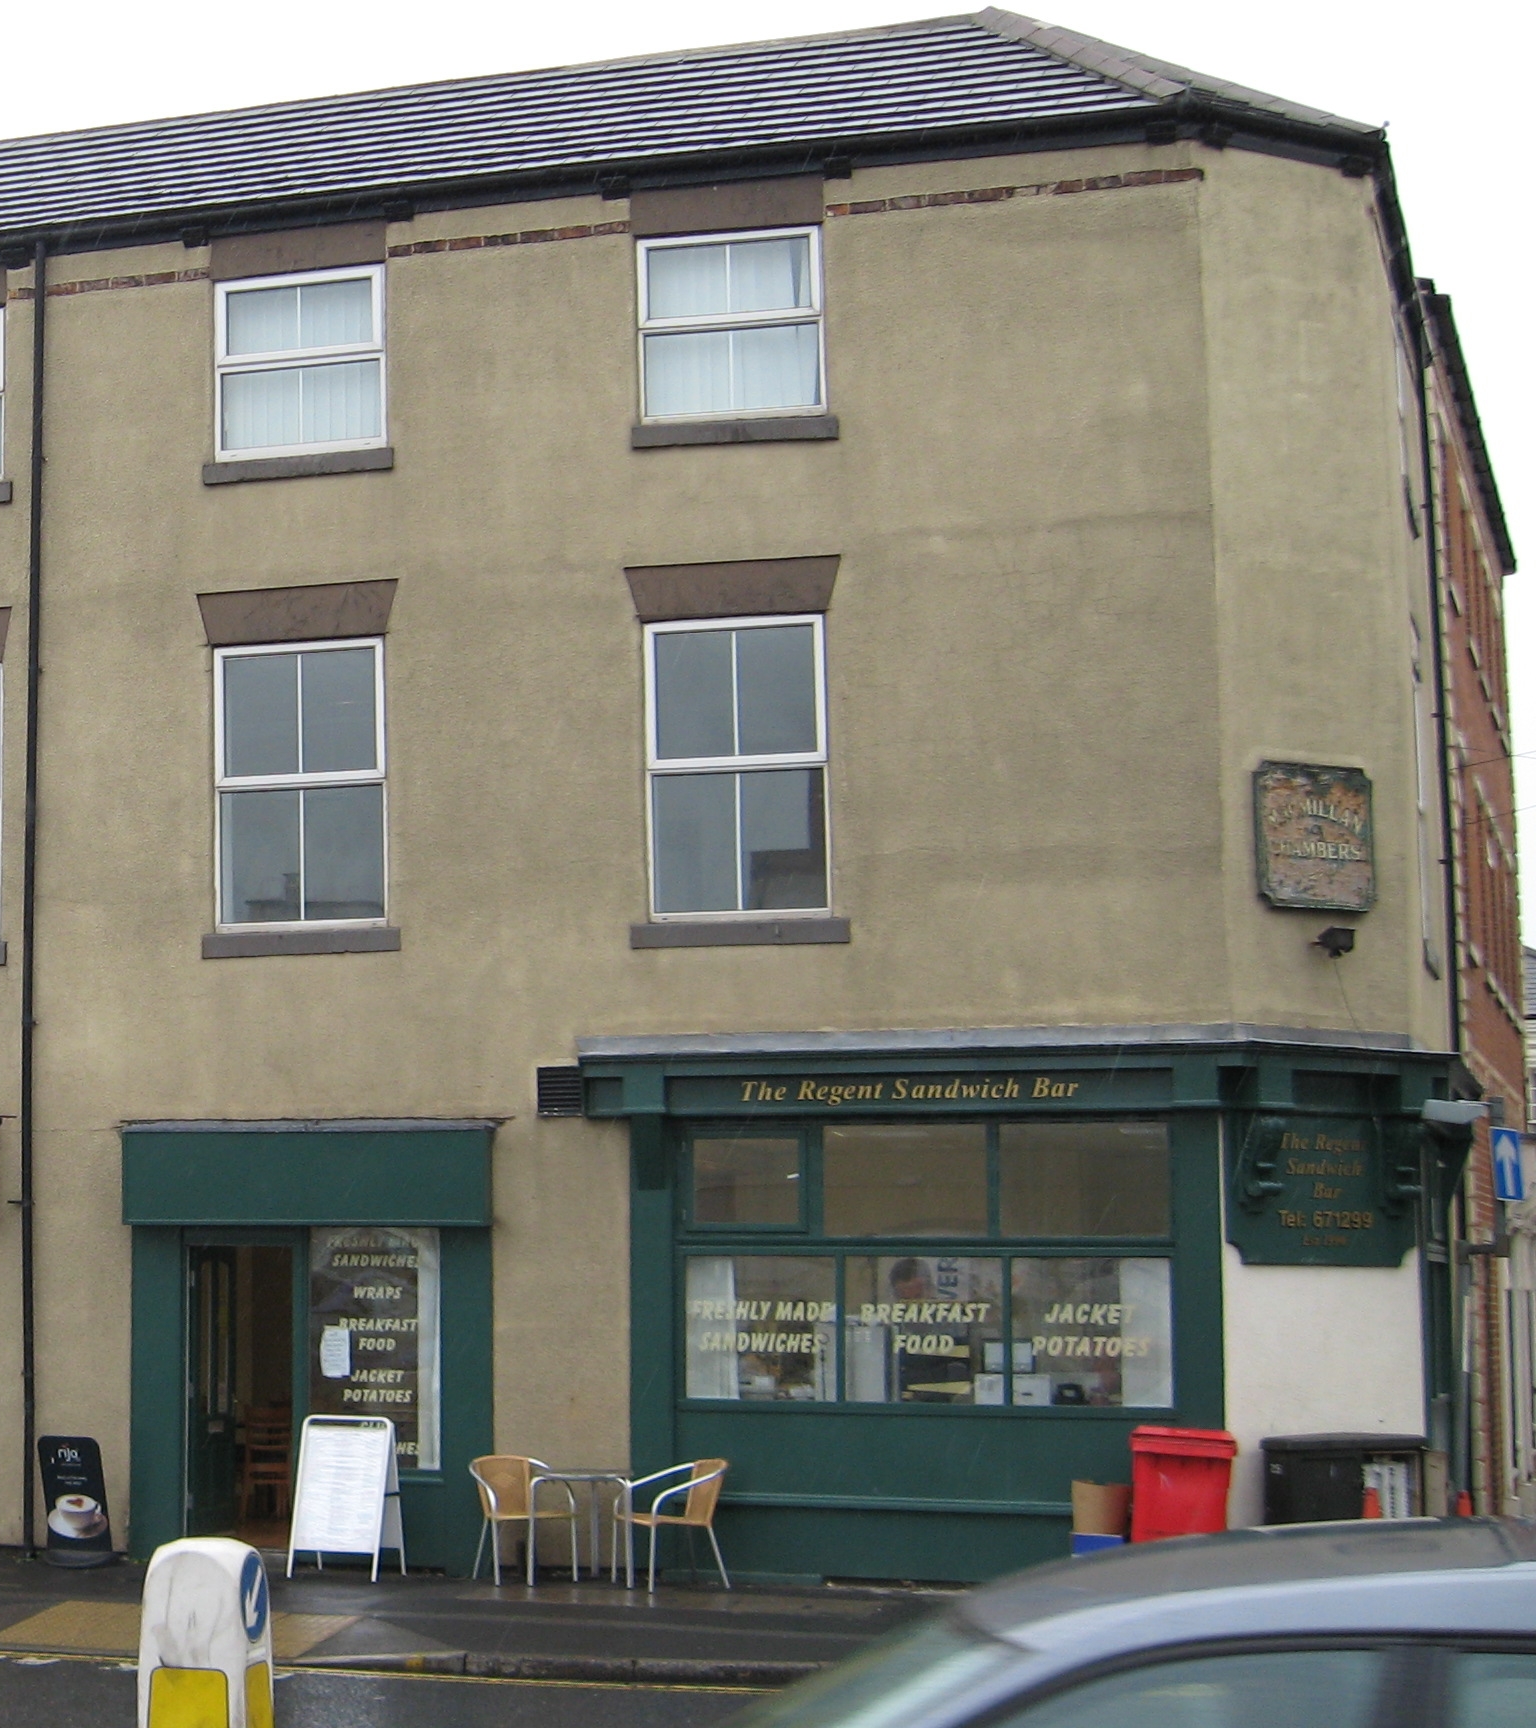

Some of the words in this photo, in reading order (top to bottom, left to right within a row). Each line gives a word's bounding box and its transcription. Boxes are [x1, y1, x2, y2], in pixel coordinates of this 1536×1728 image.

[1273, 841, 1360, 860] HAMBERS
[741, 1080, 786, 1101] The
[797, 1080, 884, 1106] Regent
[892, 1077, 1020, 1100] Sandwich
[1032, 1076, 1080, 1098] Bar
[1286, 1157, 1363, 1176] Sandwich
[1313, 1181, 1343, 1199] Bar
[1312, 1210, 1374, 1229] 671299
[352, 1285, 404, 1300] WRAPS
[693, 1300, 772, 1320] FRESHLY
[774, 1300, 834, 1321] MADE
[860, 1303, 991, 1324] BREAKFAST
[1044, 1303, 1136, 1326] JACKET
[339, 1318, 419, 1332] BREAKFAST
[358, 1337, 397, 1351] FOOD
[698, 1331, 824, 1353] SANDWICHES
[893, 1334, 955, 1355] FOOD
[1031, 1335, 1152, 1357] POTATOES
[350, 1369, 404, 1383] JACKET
[342, 1388, 413, 1403] POTATOES
